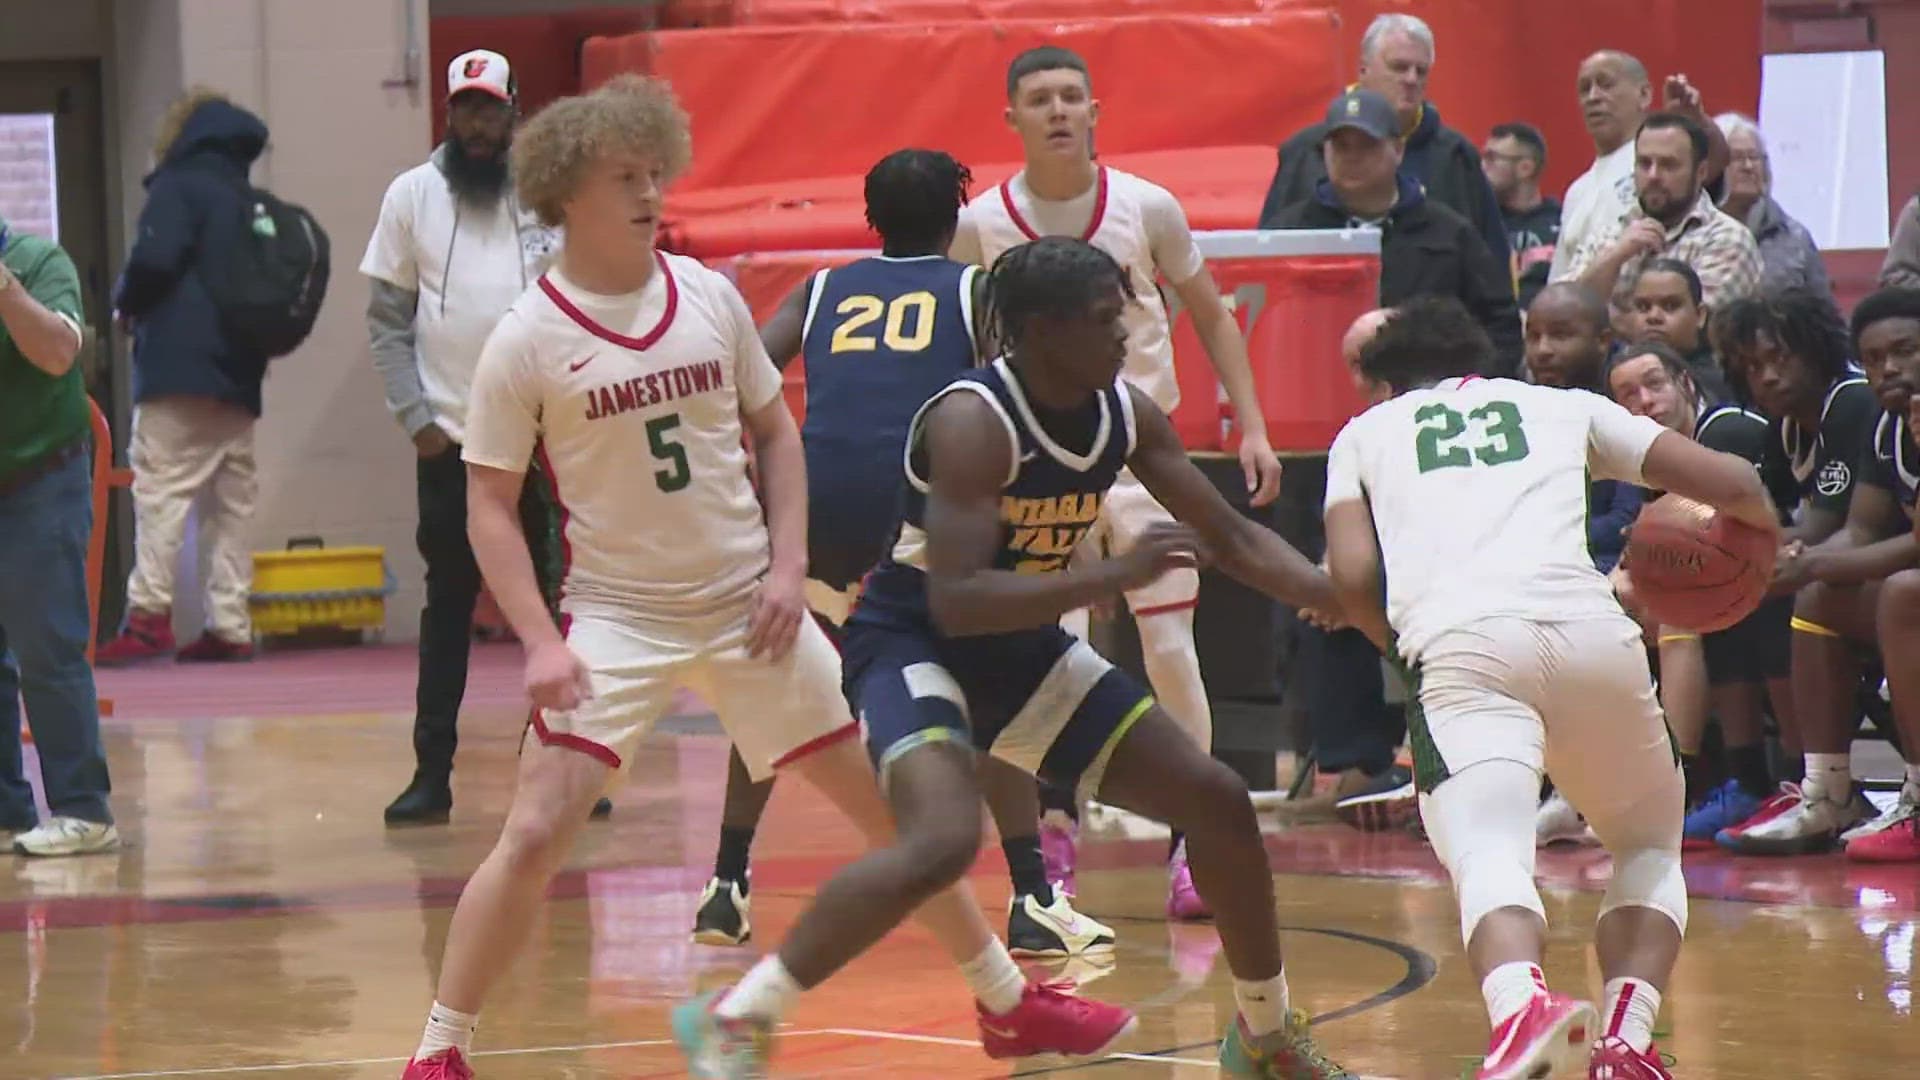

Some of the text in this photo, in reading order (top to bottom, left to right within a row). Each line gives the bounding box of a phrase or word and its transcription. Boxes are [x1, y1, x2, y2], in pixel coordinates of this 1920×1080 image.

[831, 290, 937, 354] 20
[585, 360, 723, 420] JAMESTOWN
[645, 413, 691, 493] 5
[1414, 401, 1530, 474] 23
